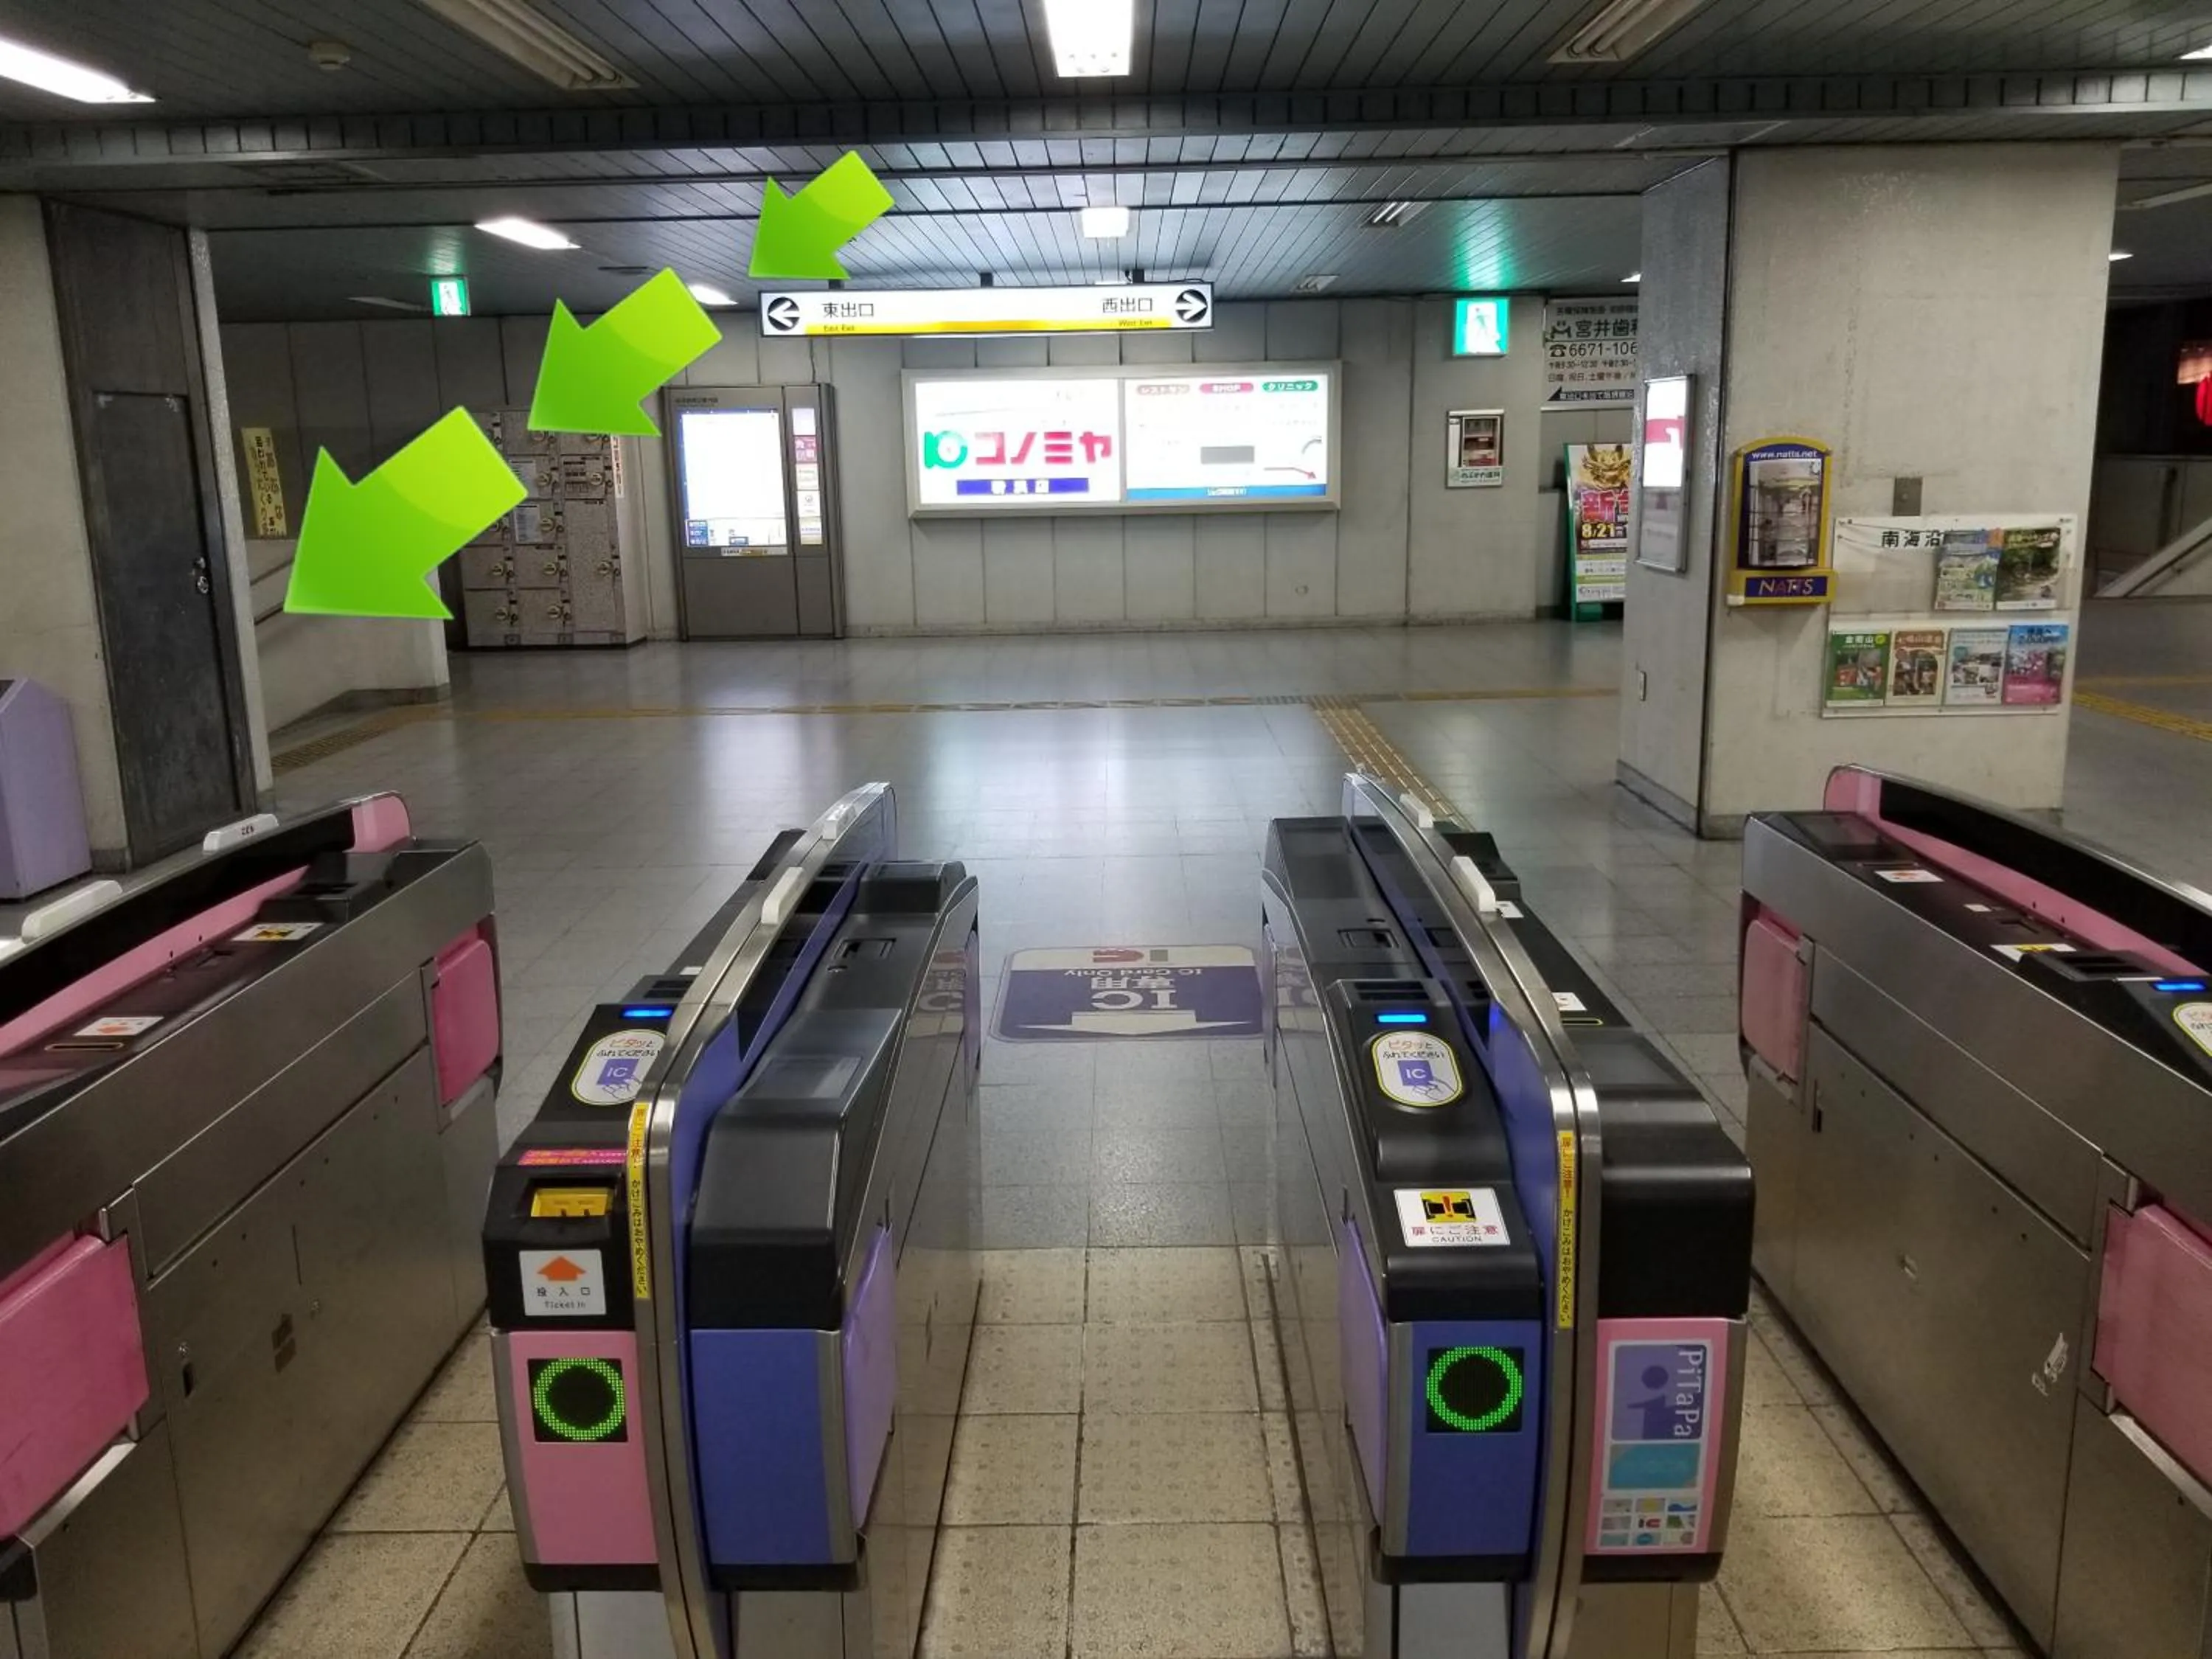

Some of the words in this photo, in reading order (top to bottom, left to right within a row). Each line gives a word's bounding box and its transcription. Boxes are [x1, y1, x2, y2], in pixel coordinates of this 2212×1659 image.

[821, 302, 874, 319] 東出口
[1102, 297, 1152, 313] 西出口
[1267, 382, 1313, 392] クリニック
[974, 431, 1113, 465] コノミヤ
[1121, 968, 1172, 976] Card
[1091, 976, 1175, 990] 専用
[1091, 990, 1178, 1010] IC
[607, 1067, 628, 1077] IC
[1406, 1068, 1427, 1079] IC
[1411, 1225, 1499, 1236] 扉にご注意
[1432, 1235, 1482, 1243] CAUTION
[537, 1287, 591, 1297] 投入口
[545, 1301, 574, 1309] Ticket
[1673, 1349, 1705, 1436] PiTaPa
